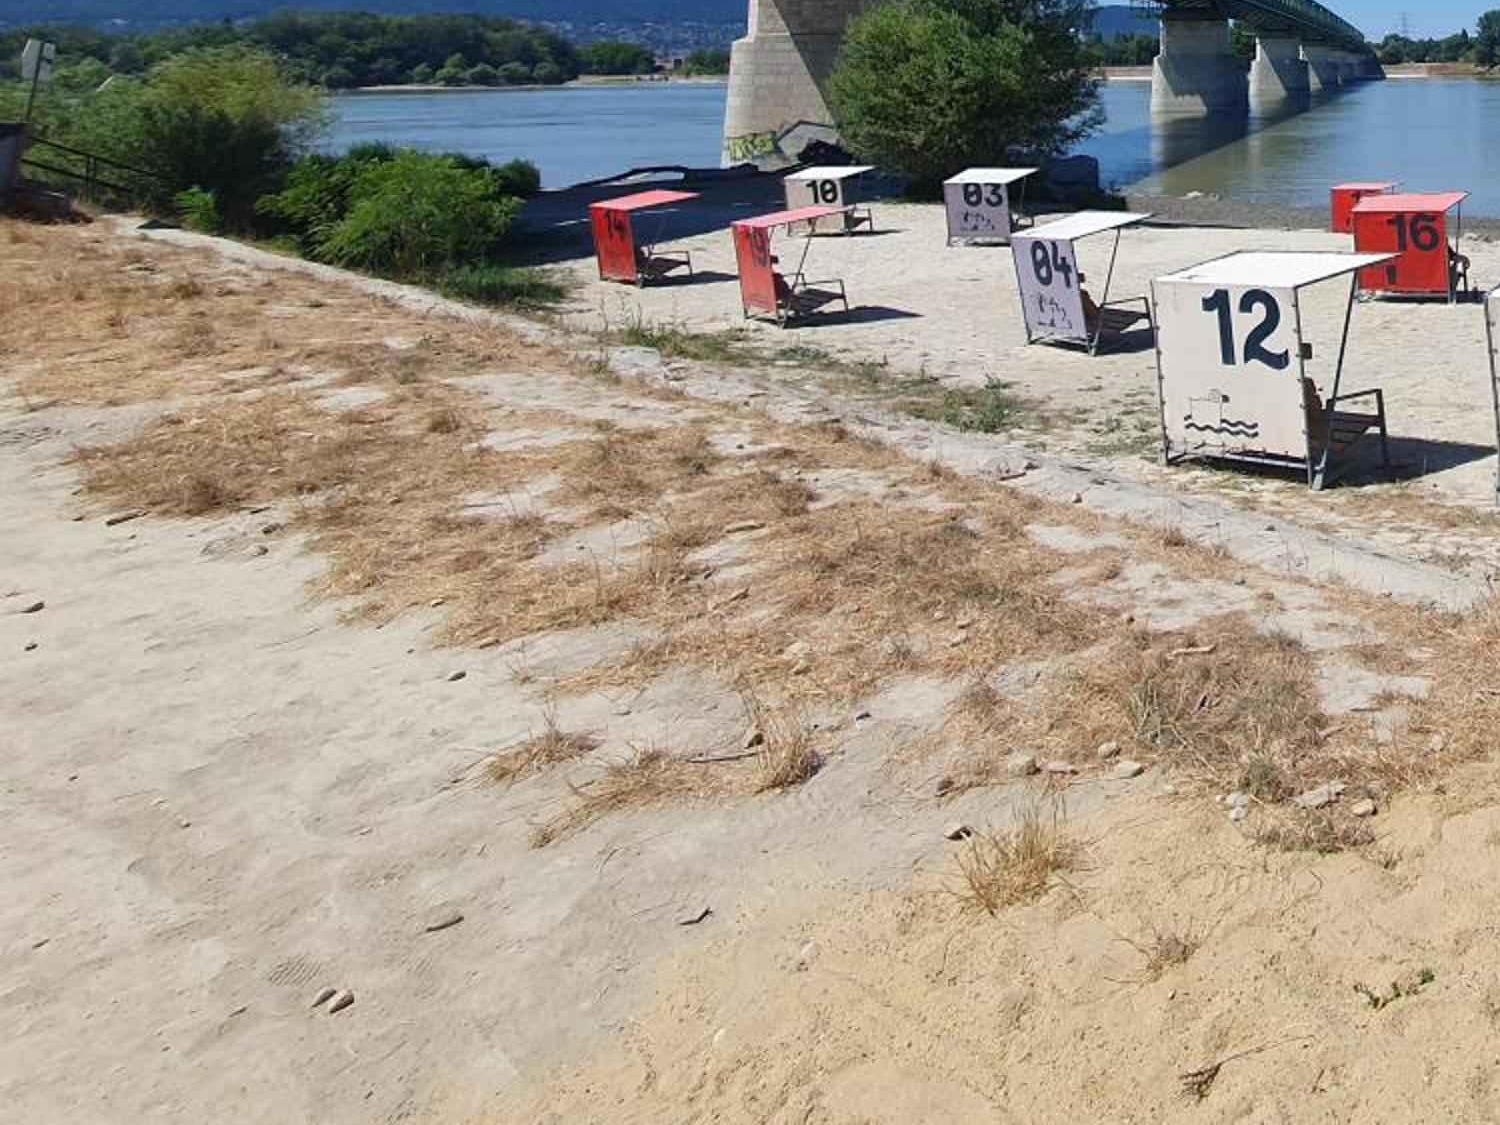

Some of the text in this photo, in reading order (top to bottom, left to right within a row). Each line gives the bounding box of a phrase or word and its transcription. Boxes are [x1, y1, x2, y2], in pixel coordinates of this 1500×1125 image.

[806, 179, 838, 203] 10
[963, 183, 1003, 207] 03
[1387, 213, 1439, 252] 16
[1031, 240, 1072, 288] 04
[1202, 289, 1289, 370] 12
